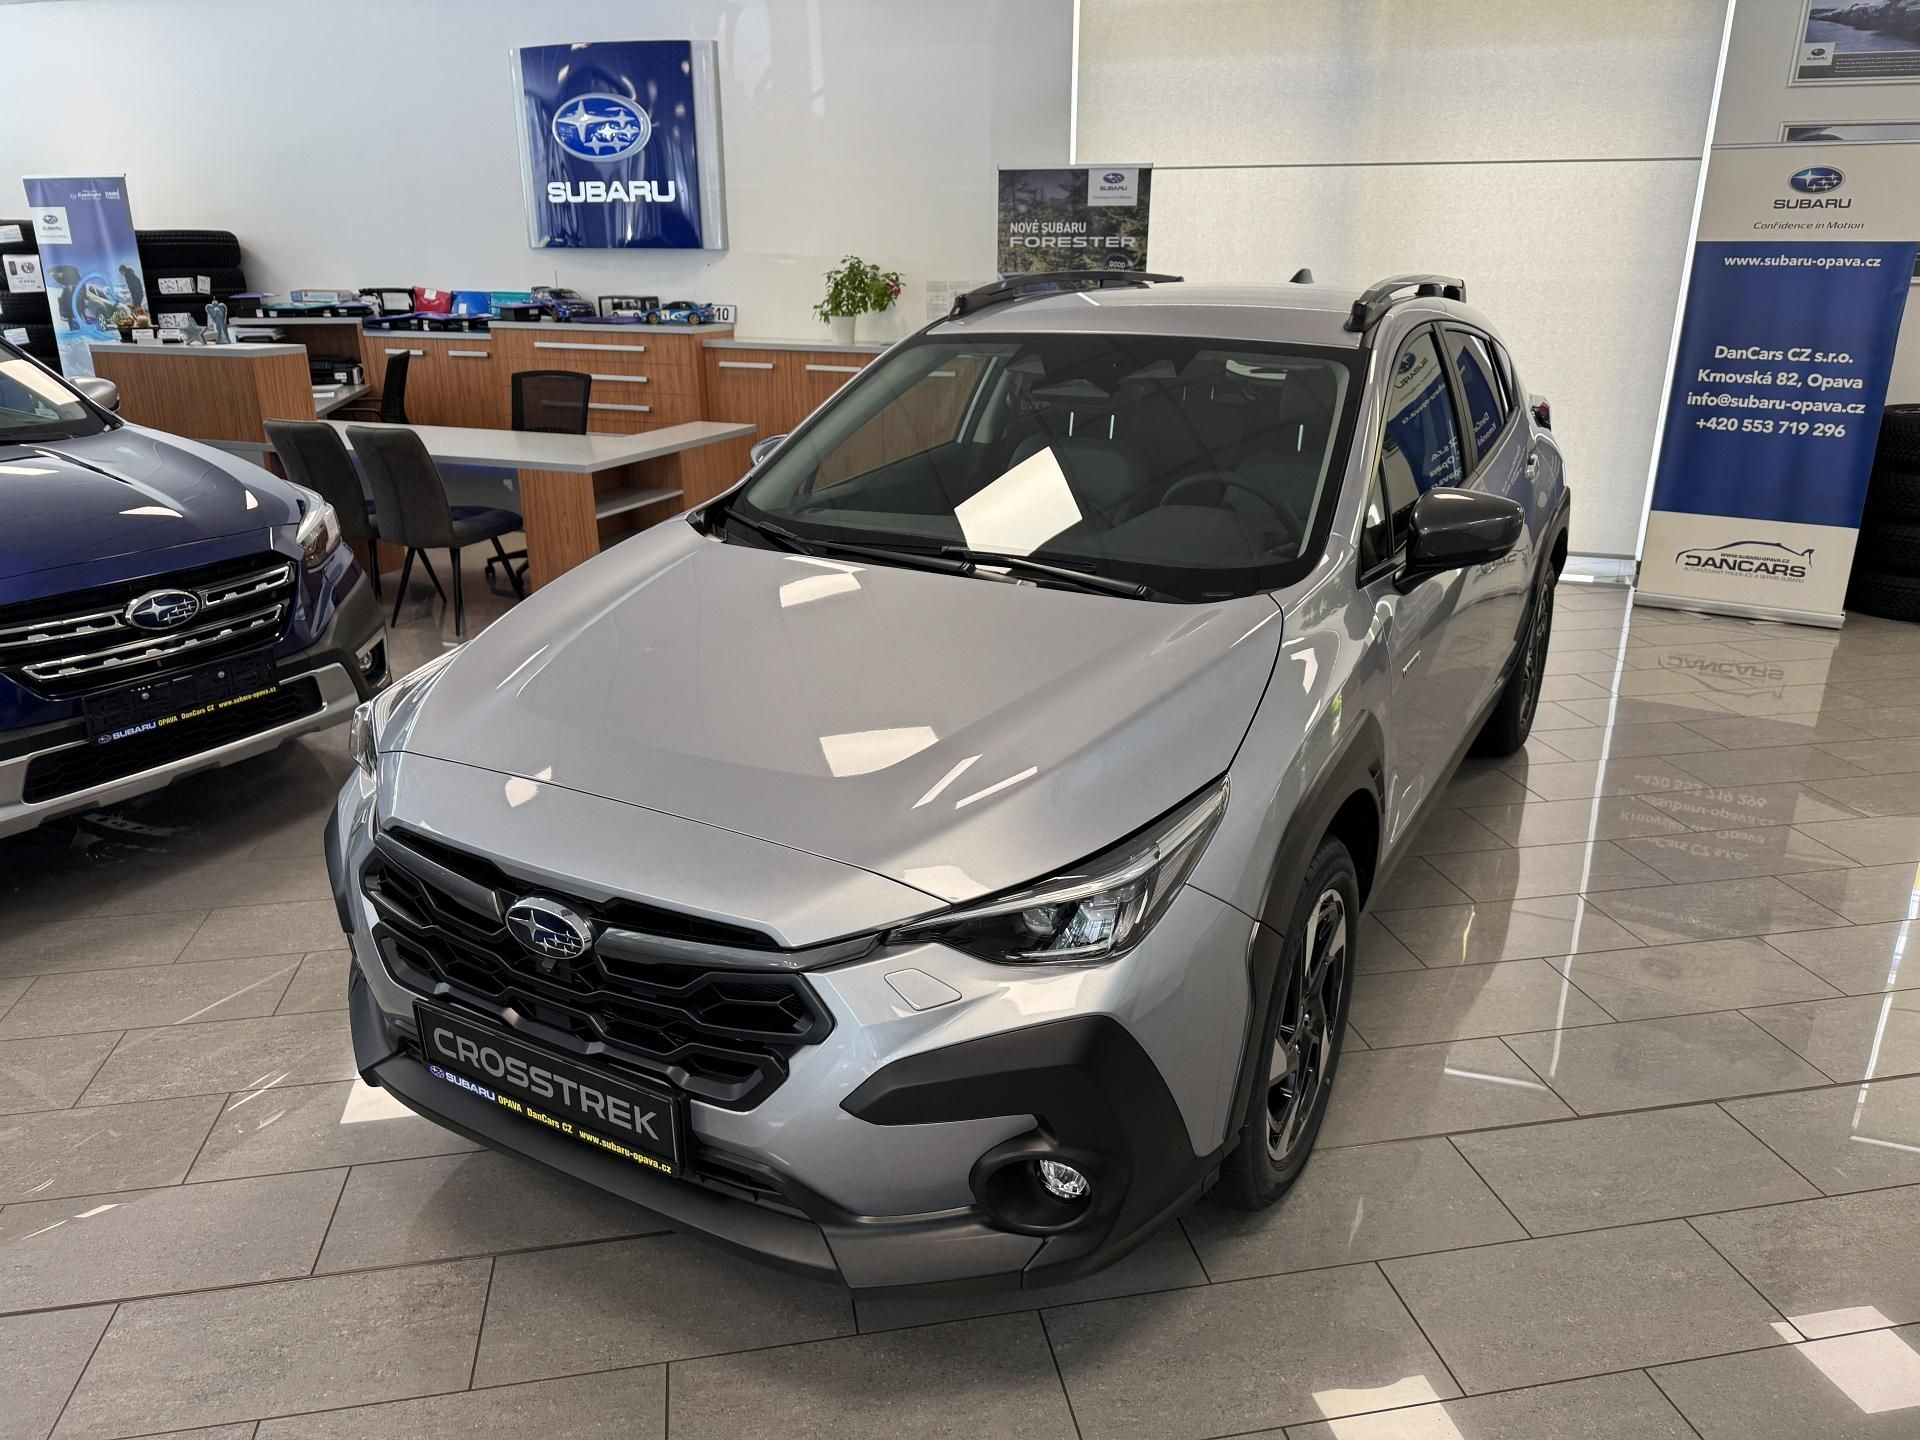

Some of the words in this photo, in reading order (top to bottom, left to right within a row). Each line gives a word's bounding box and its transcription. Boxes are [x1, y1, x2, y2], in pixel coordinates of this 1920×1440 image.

[547, 180, 676, 203] SUBARU
[1773, 198, 1852, 209] SUBARU
[1010, 219, 1039, 233] NOVÉ
[1041, 222, 1087, 233] SUBARU
[1753, 221, 1813, 230] Confidence
[1815, 221, 1825, 229] in
[1826, 221, 1864, 230] Motion
[1009, 236, 1136, 248] FORESTER
[1724, 254, 1881, 269] www.subaru-opava.cz
[1714, 345, 1784, 361] DanCars
[1787, 348, 1812, 362] CZ
[1814, 351, 1854, 364] s.r.o.
[1697, 369, 1773, 386] Krnovská
[1776, 372, 1803, 388] 82,
[1807, 373, 1864, 391] Opava
[1686, 392, 1867, 415] info@subaru-opava.cz
[1696, 417, 1738, 431] +420
[1741, 419, 1774, 433] 553
[1778, 421, 1810, 435] 719
[1812, 423, 1846, 438] 296
[1684, 554, 1807, 578] DANCARS
[112, 721, 157, 740] SUBARU
[158, 715, 178, 727] OPAVA
[206, 704, 215, 712] CZ
[433, 1027, 660, 1142] CROSSTREK
[445, 1072, 496, 1101] SUBARU
[498, 1095, 522, 1114] OPAVA
[527, 1107, 560, 1130] DanCars
[562, 1122, 573, 1134] CZ
[579, 1129, 672, 1174] www.subaru-opava.cz
